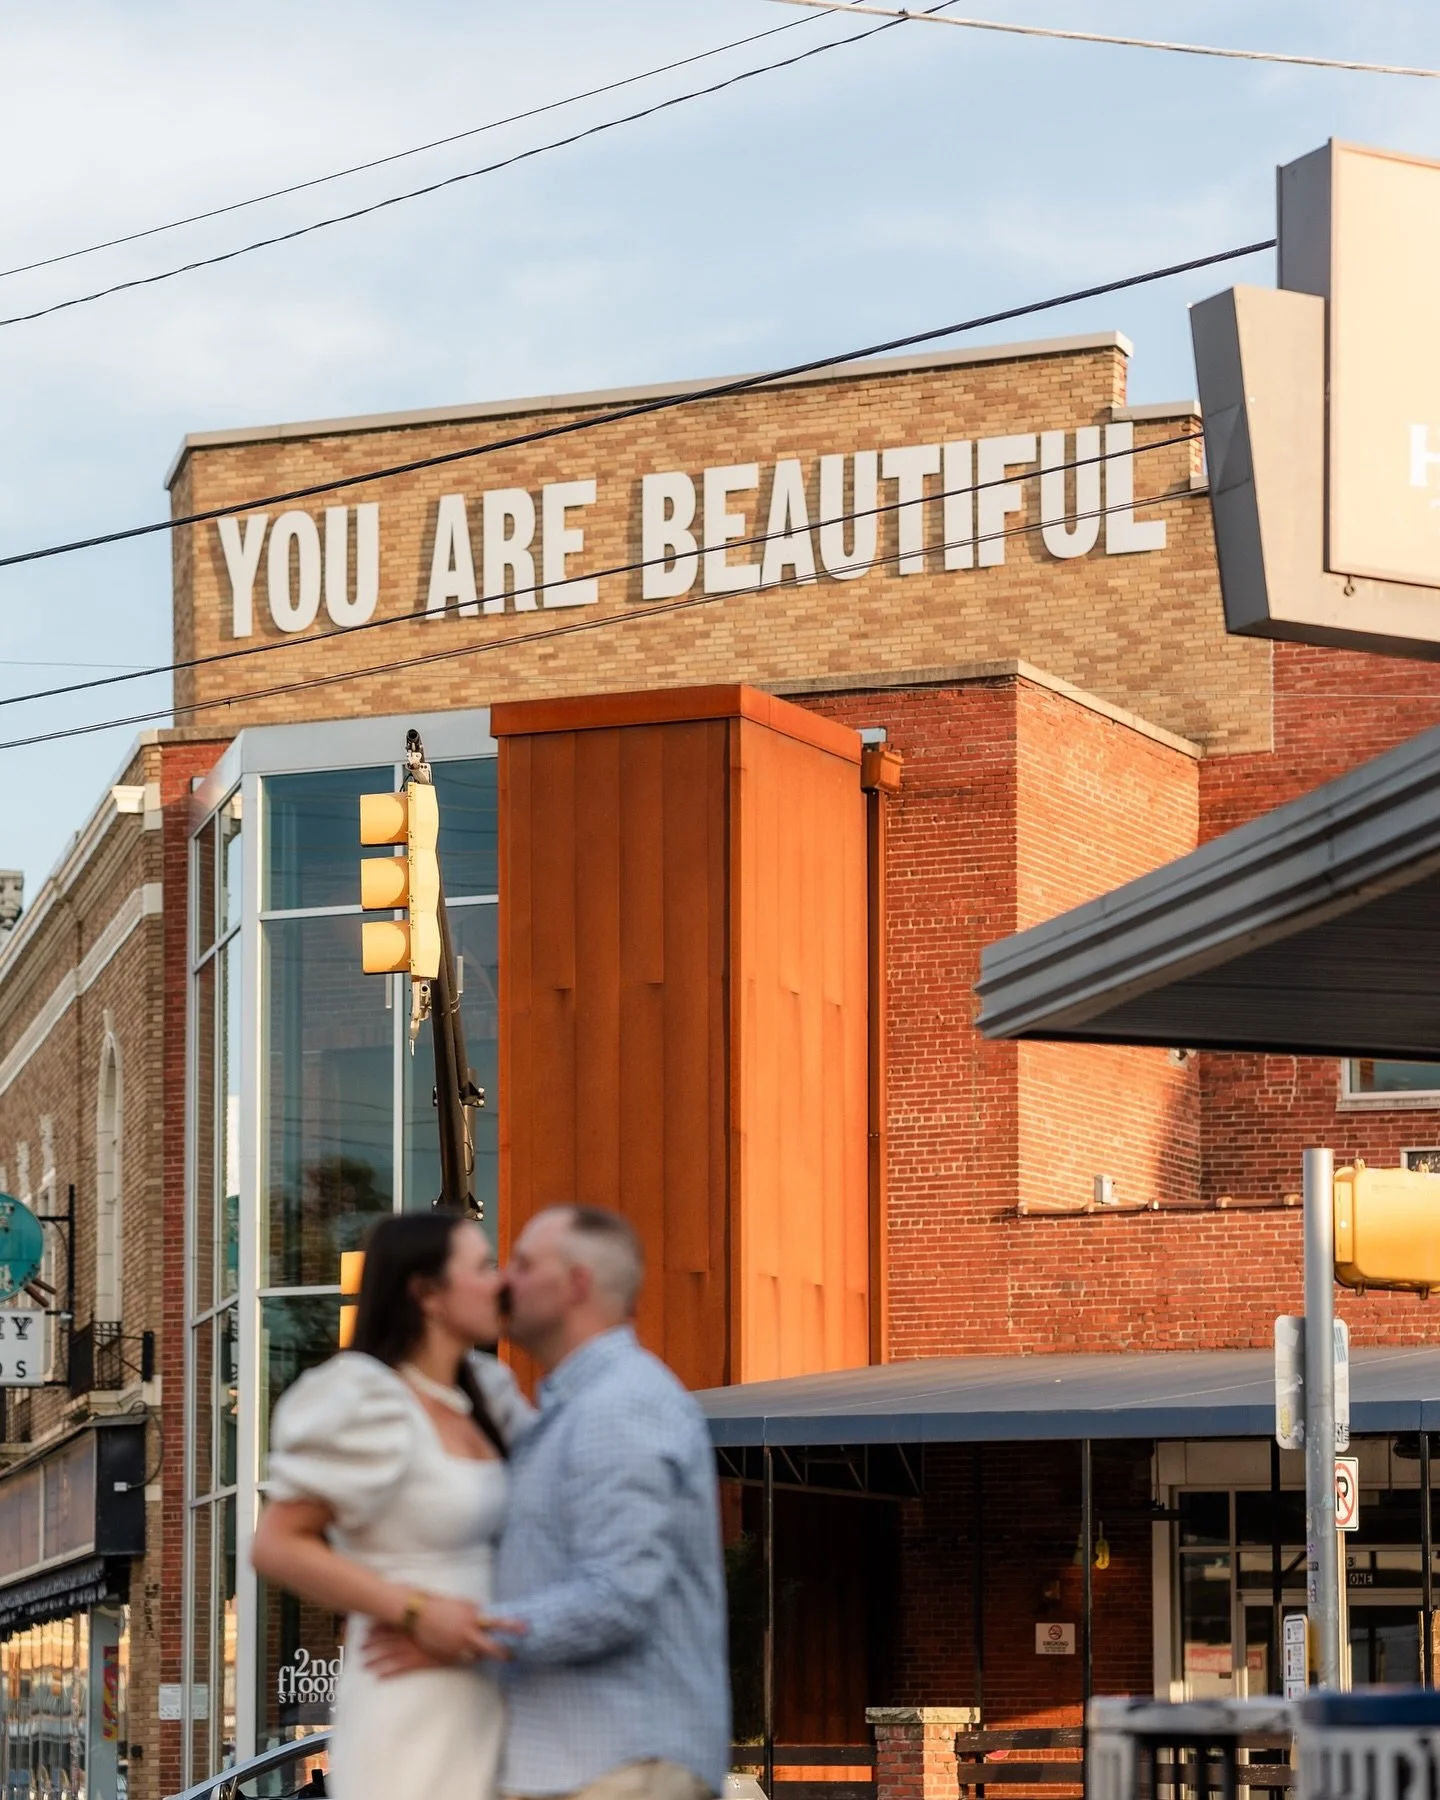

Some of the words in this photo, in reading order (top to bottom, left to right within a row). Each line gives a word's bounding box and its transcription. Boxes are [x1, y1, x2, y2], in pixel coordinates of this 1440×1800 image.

[217, 503, 379, 638] YOU
[425, 480, 598, 620] ARE
[642, 421, 1167, 599] BEAUTIFUL
[294, 1646, 345, 1677] 2nd
[277, 1666, 339, 1693] floor
